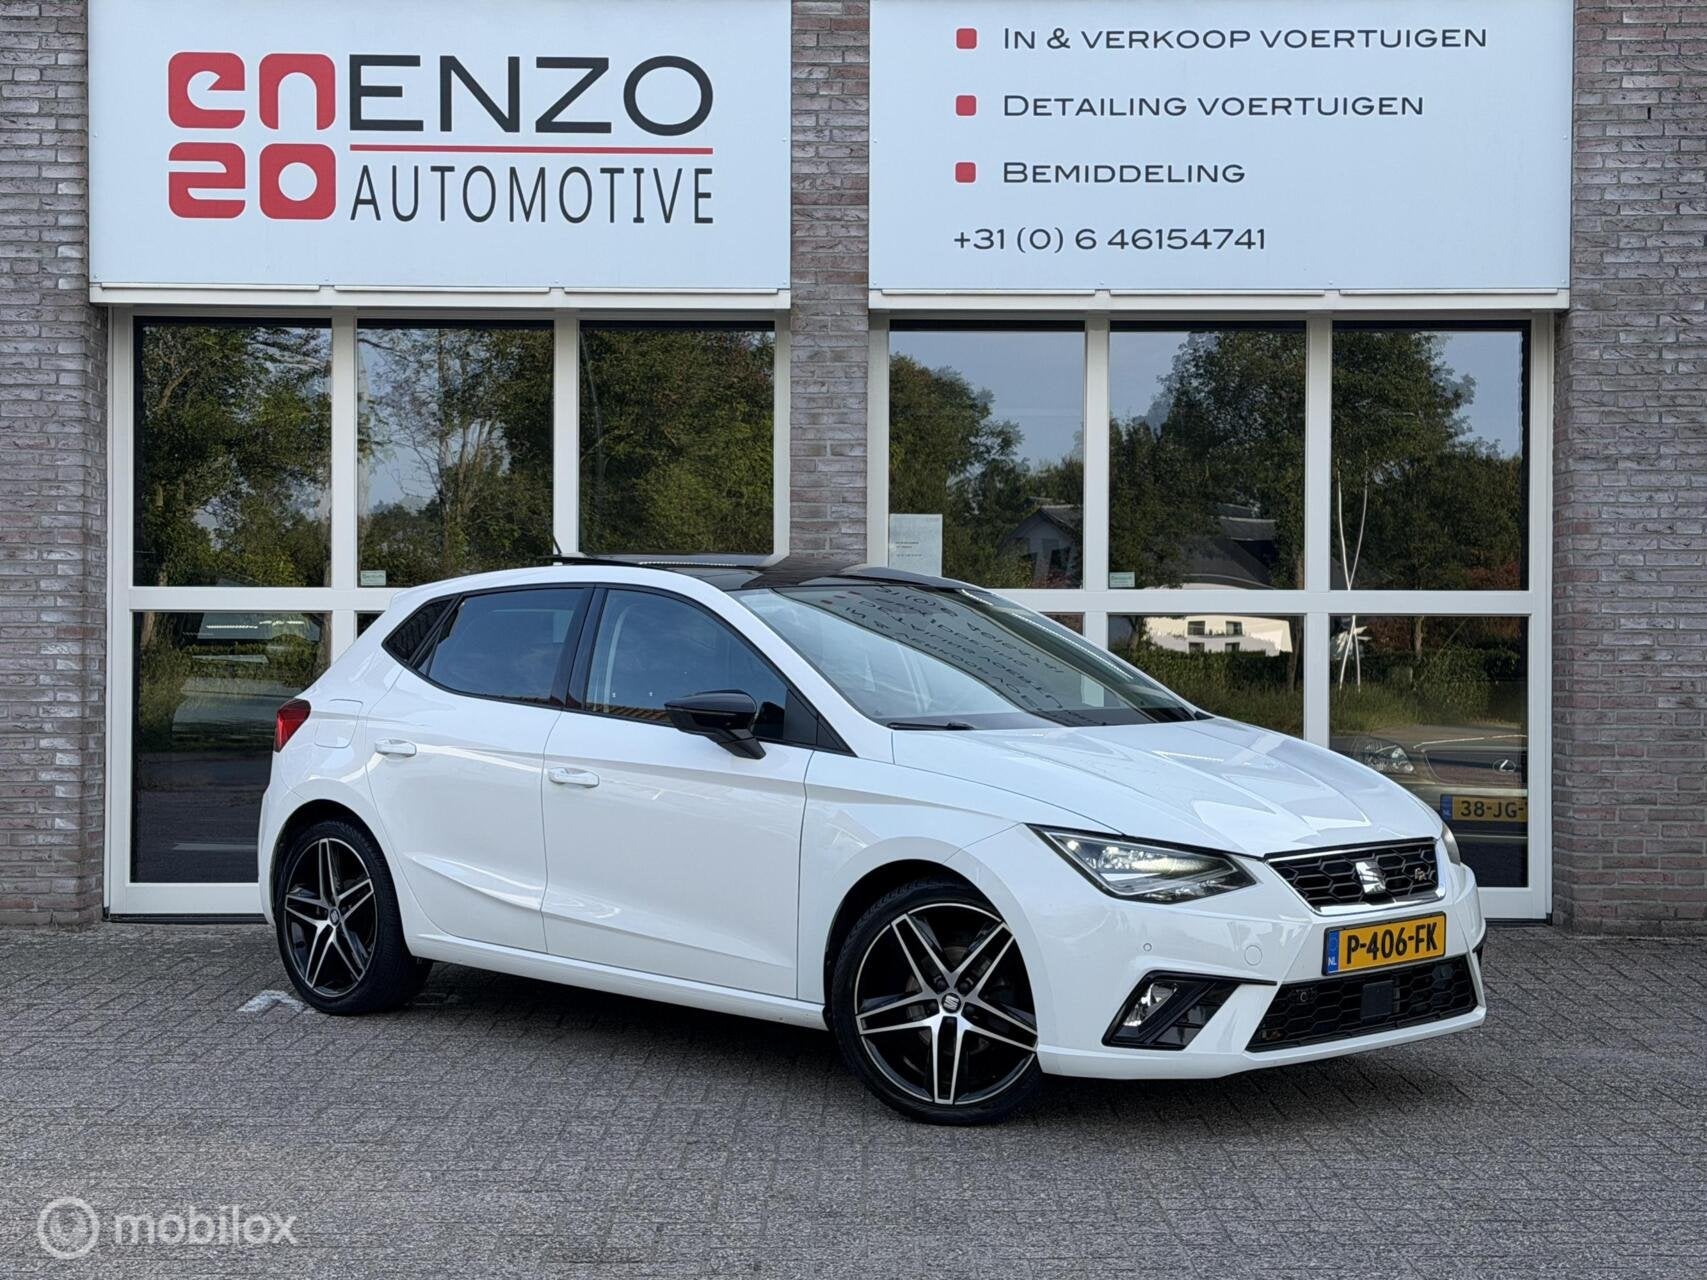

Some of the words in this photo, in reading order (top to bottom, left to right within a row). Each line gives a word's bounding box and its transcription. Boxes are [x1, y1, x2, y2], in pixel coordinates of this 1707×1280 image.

[1046, 27, 1071, 49] &
[1081, 29, 1252, 49] VERKOOP
[1260, 28, 1486, 49] VOERTUIGEN
[349, 54, 714, 137] ENZO
[1004, 95, 1187, 116] DETAILING
[1197, 96, 1423, 116] VOERTUIGEN
[1003, 162, 1245, 183] BEMIDDELING
[350, 164, 714, 224] AUTOMOTIVE
[954, 228, 1005, 250] +31
[1017, 227, 1064, 253] (0)
[1075, 228, 1097, 250] 6
[1107, 228, 1265, 250] 46154741
[1460, 800, 1528, 818] 38-JG-
[1346, 921, 1438, 965] P-406-FK
